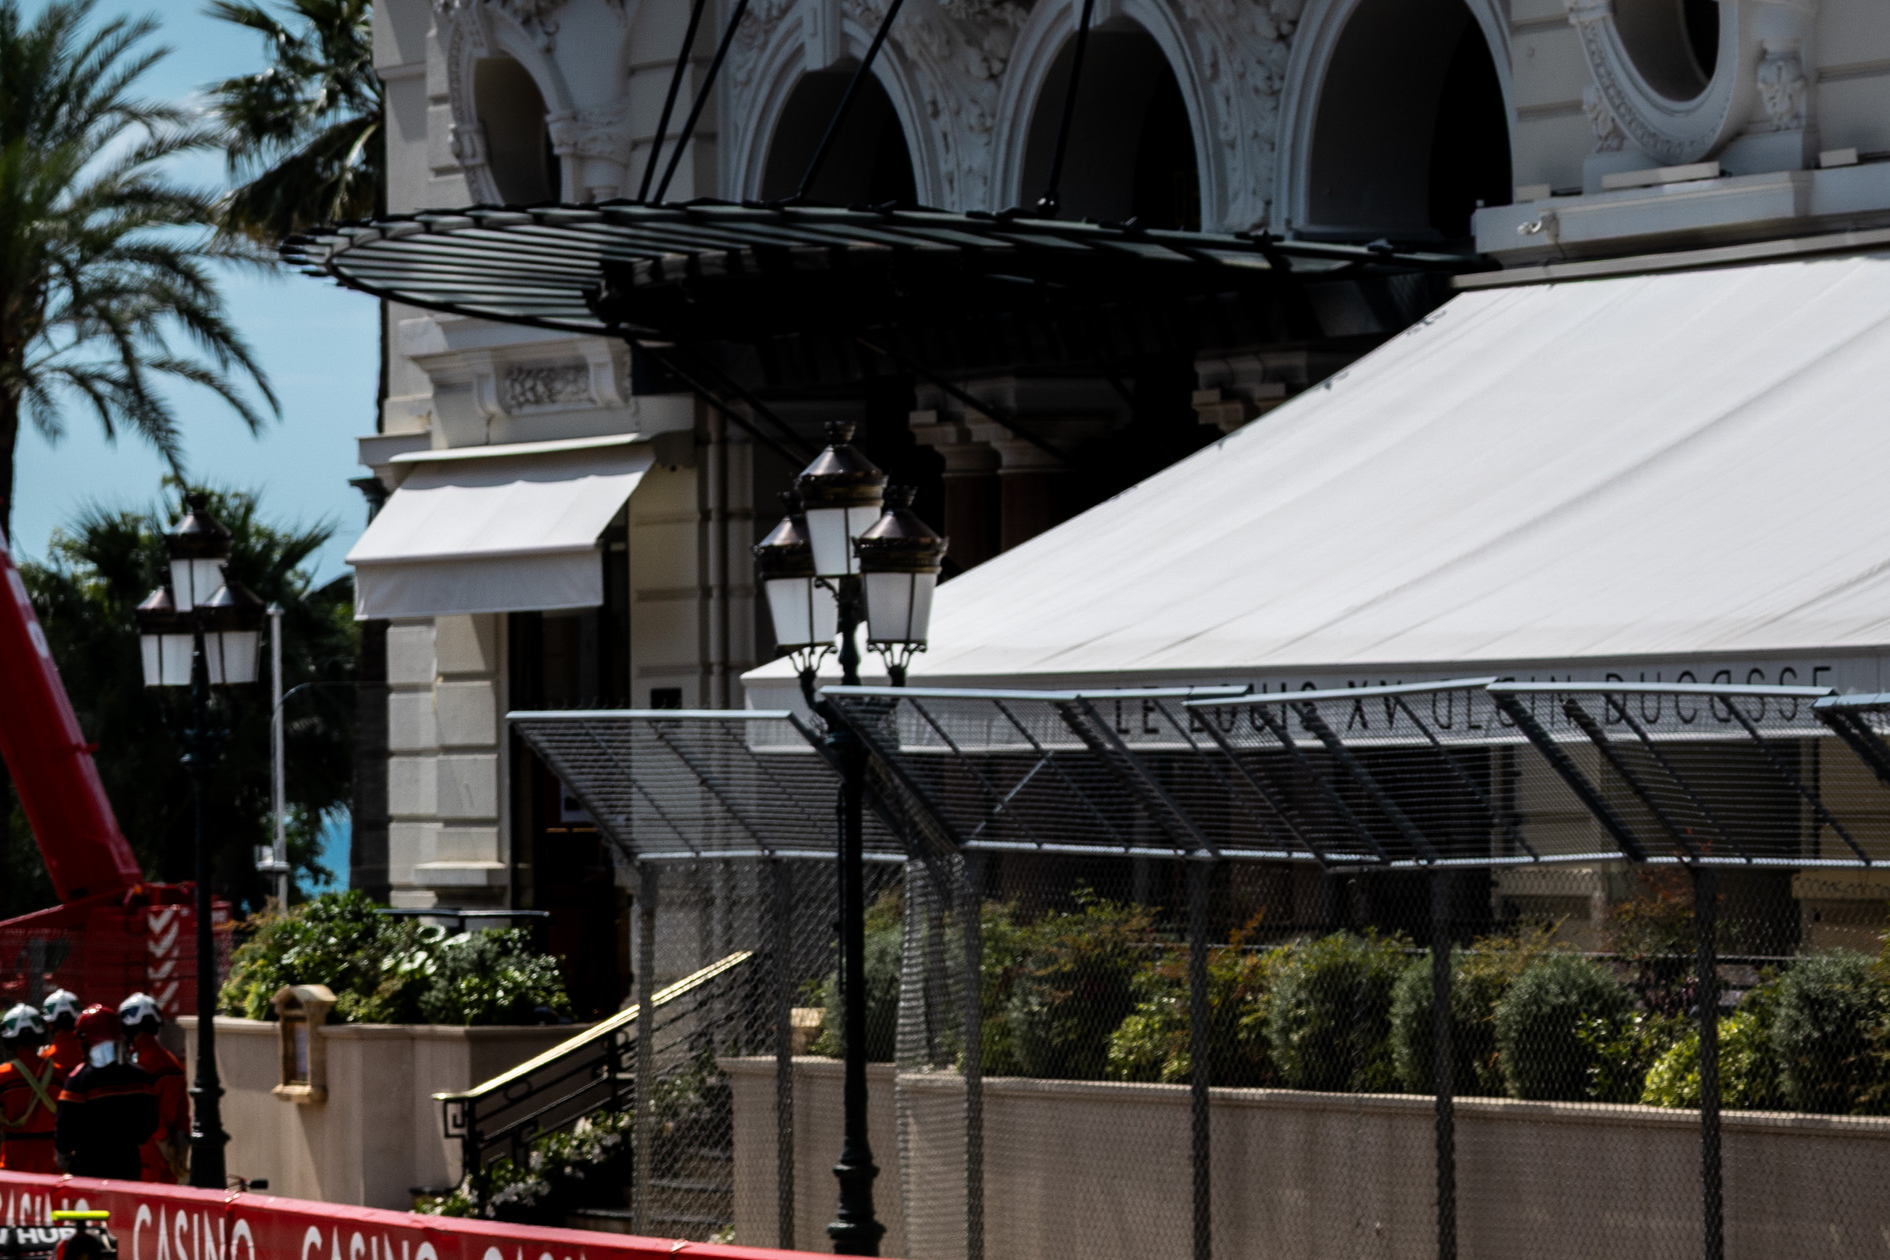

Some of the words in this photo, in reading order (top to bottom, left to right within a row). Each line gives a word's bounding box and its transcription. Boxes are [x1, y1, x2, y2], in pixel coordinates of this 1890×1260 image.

[1115, 687, 1159, 735] LE
[1190, 680, 1318, 734] LOUIS
[1348, 680, 1401, 732] XV
